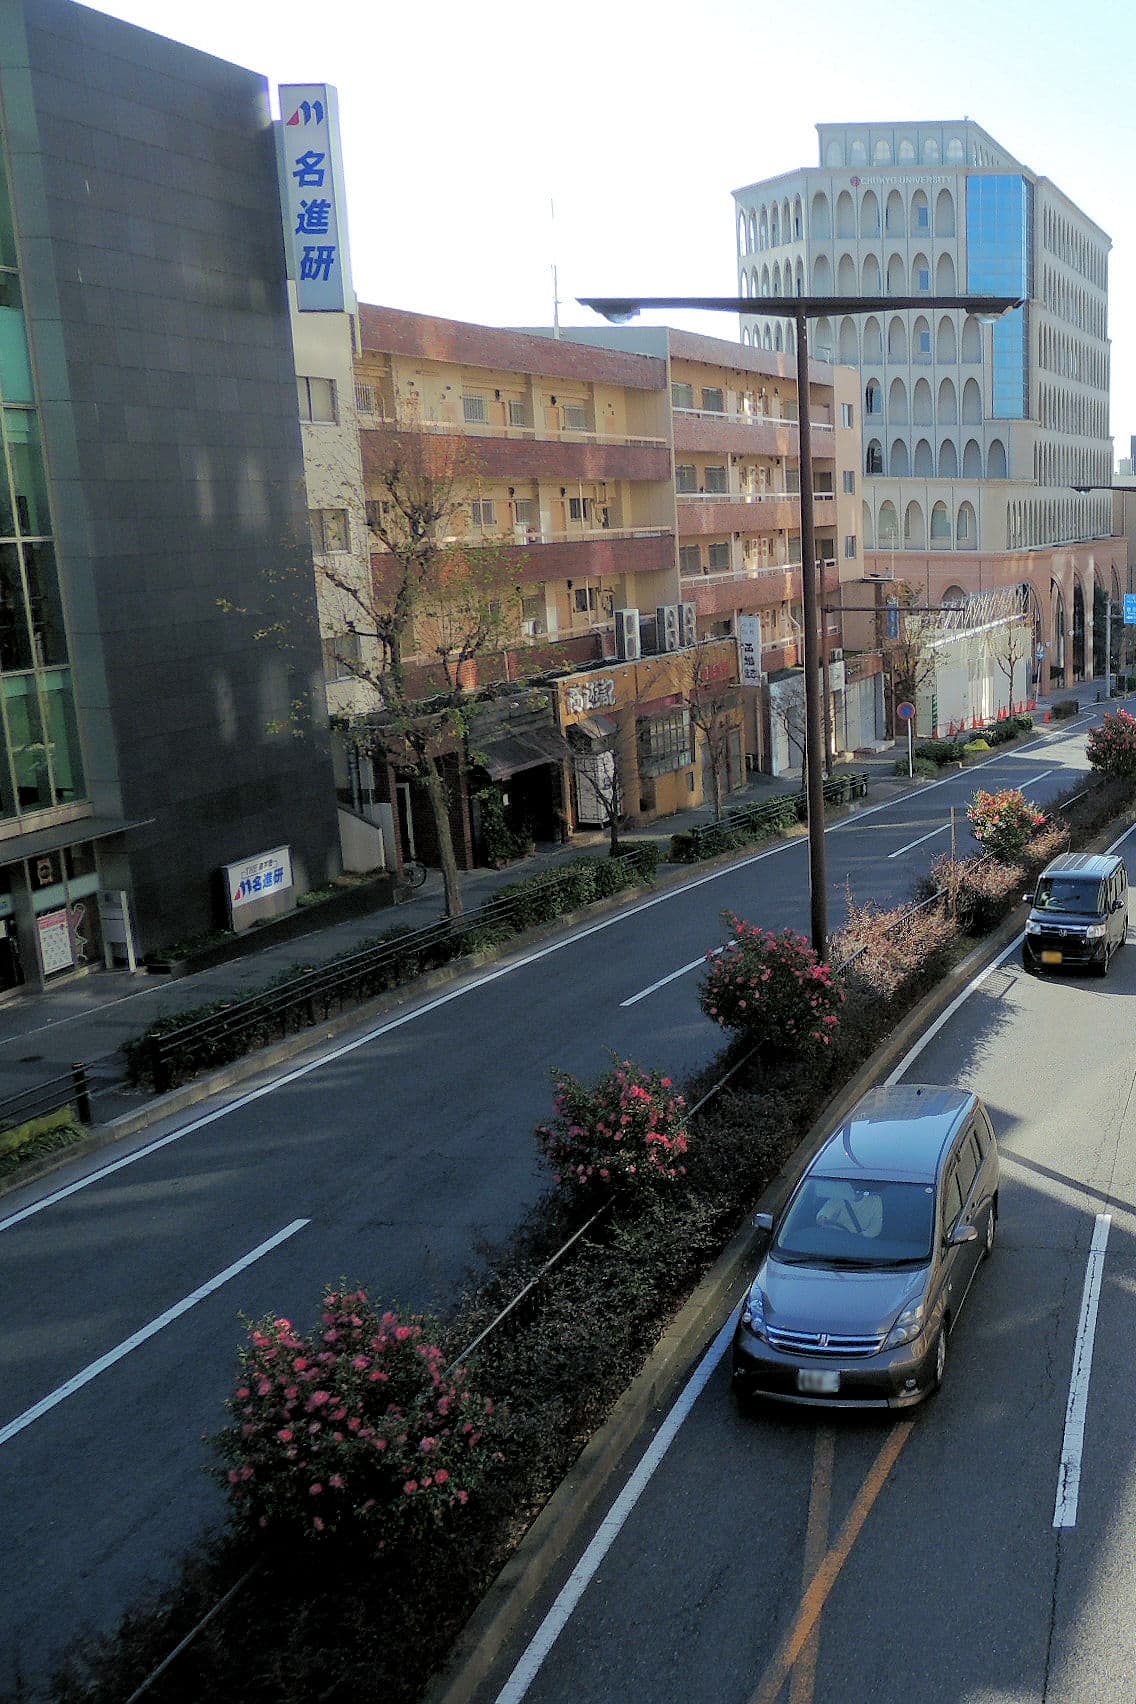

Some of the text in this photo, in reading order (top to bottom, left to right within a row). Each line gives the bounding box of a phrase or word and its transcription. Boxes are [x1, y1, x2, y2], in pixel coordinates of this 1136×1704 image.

[899, 175, 952, 184] UNIVERSITY
[292, 150, 336, 281] 名進研
[253, 867, 284, 892] 名進研
